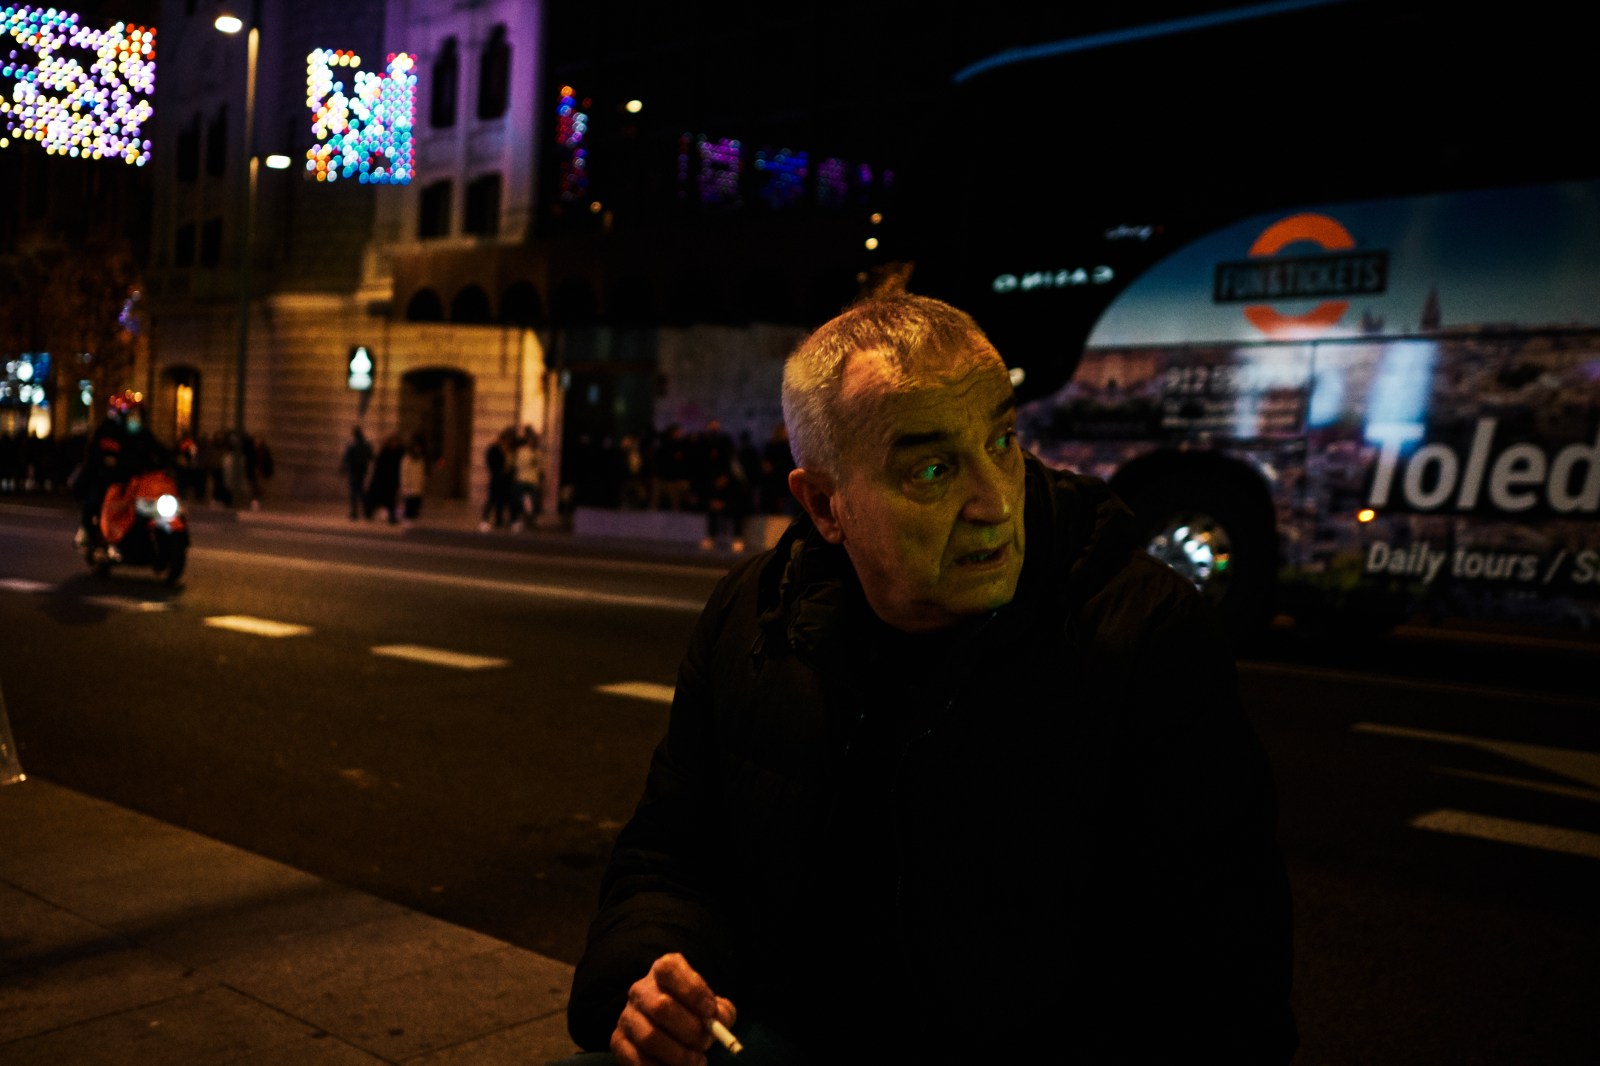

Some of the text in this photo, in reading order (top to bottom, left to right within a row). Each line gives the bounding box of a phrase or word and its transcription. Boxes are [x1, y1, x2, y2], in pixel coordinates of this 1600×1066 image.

[1366, 540, 1448, 586] Daily
[1451, 545, 1541, 582] tours
[1570, 549, 1600, 585] S
